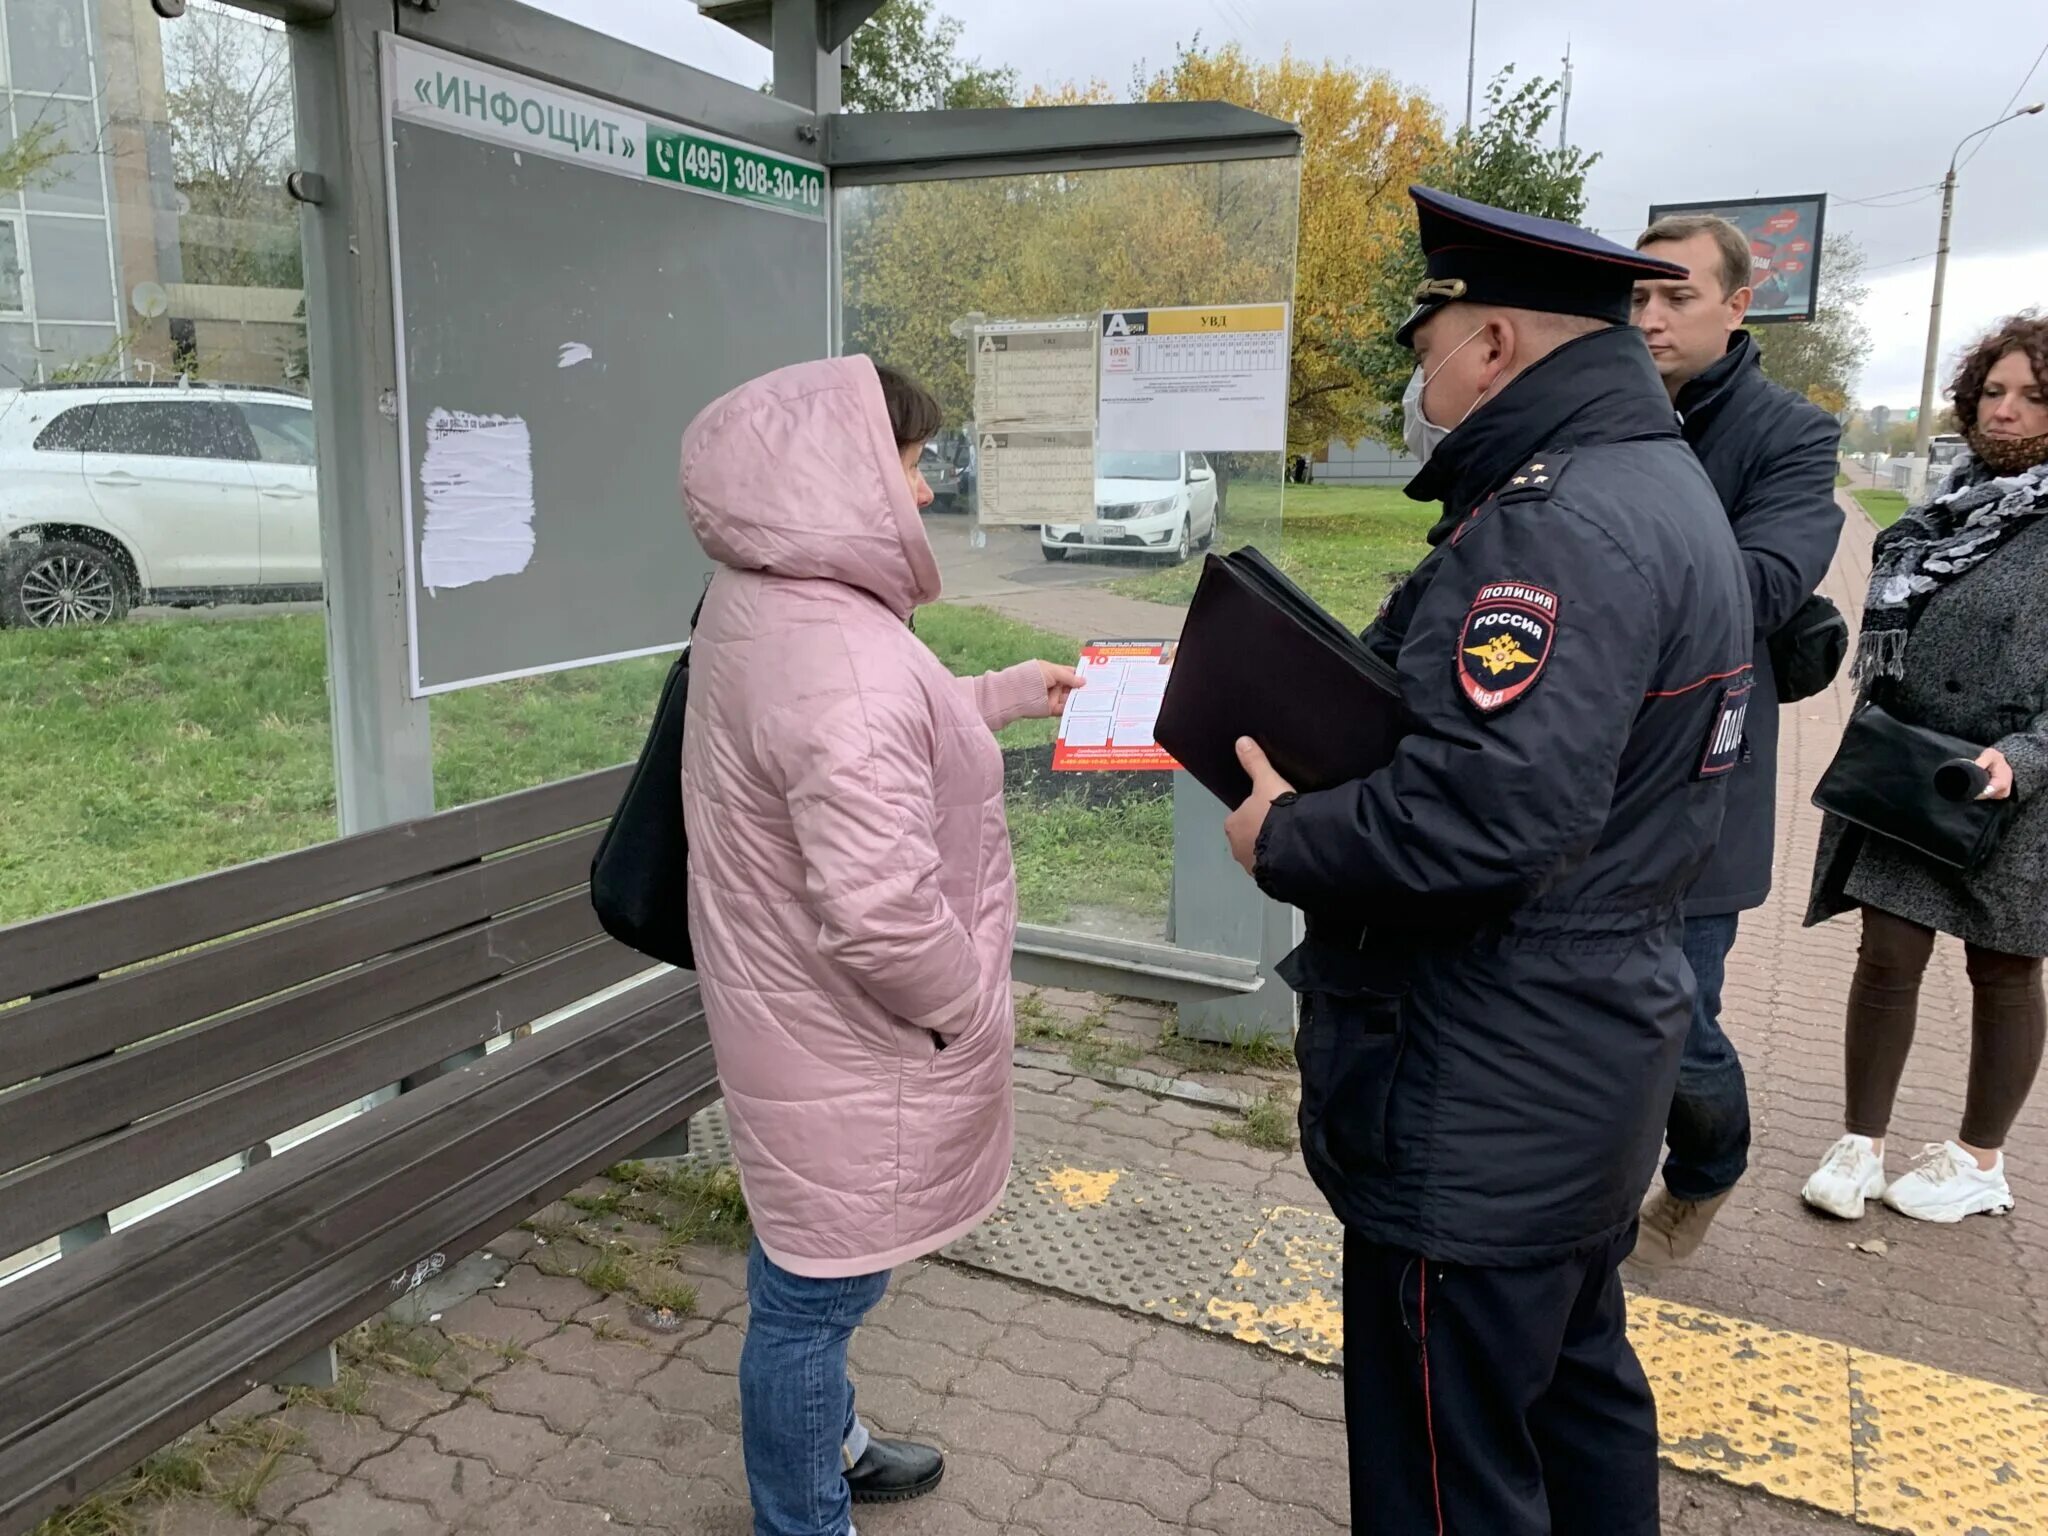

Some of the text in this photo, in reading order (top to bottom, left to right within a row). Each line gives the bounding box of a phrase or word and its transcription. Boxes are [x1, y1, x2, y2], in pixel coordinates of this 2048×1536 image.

[414, 71, 636, 159] «ИНФОЩИТ»
[678, 141, 820, 207] (495) 308-30-10
[1201, 315, 1228, 328] УВД
[1481, 586, 1553, 610] ПОЛИЦИЯ
[1474, 613, 1543, 640] РОССИЯ
[1473, 686, 1504, 708] МВД
